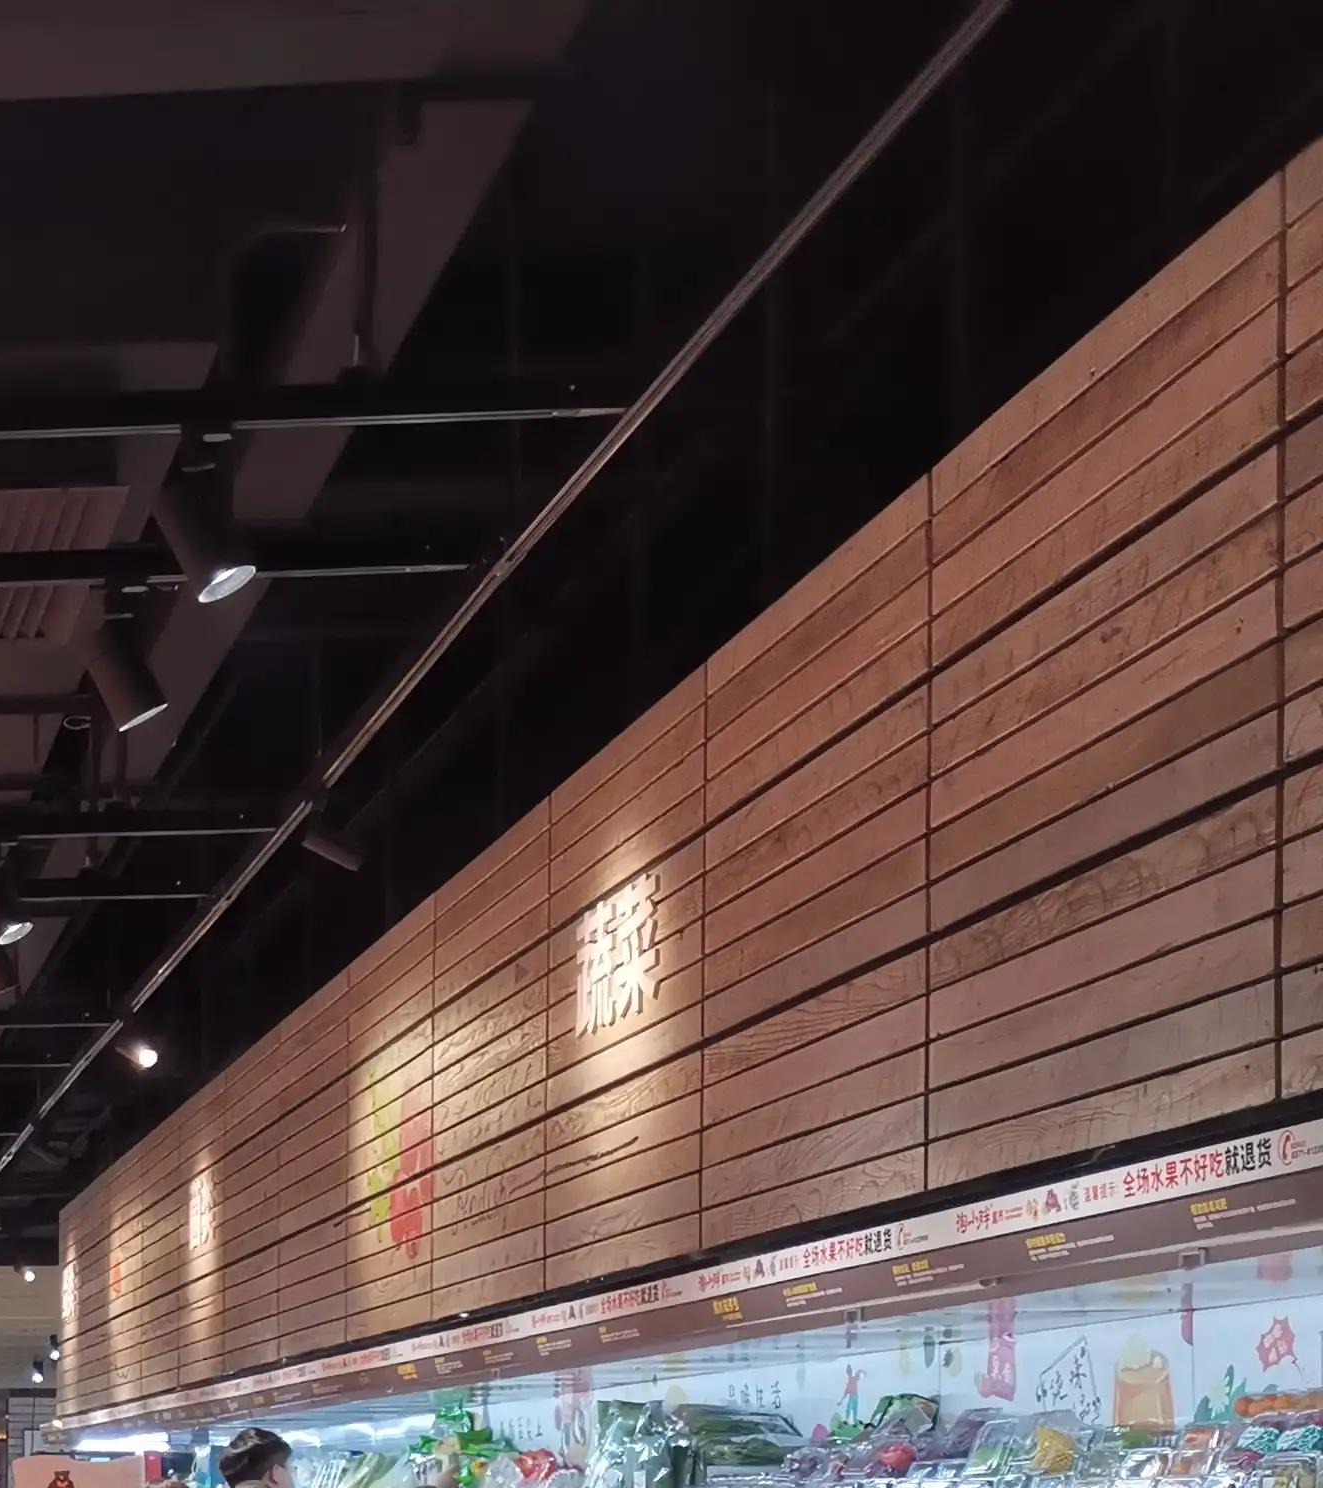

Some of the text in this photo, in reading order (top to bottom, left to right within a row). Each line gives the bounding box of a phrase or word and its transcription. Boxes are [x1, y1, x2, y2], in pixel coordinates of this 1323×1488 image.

[1122, 1137, 1273, 1199] 全场水果不好吃就退货
